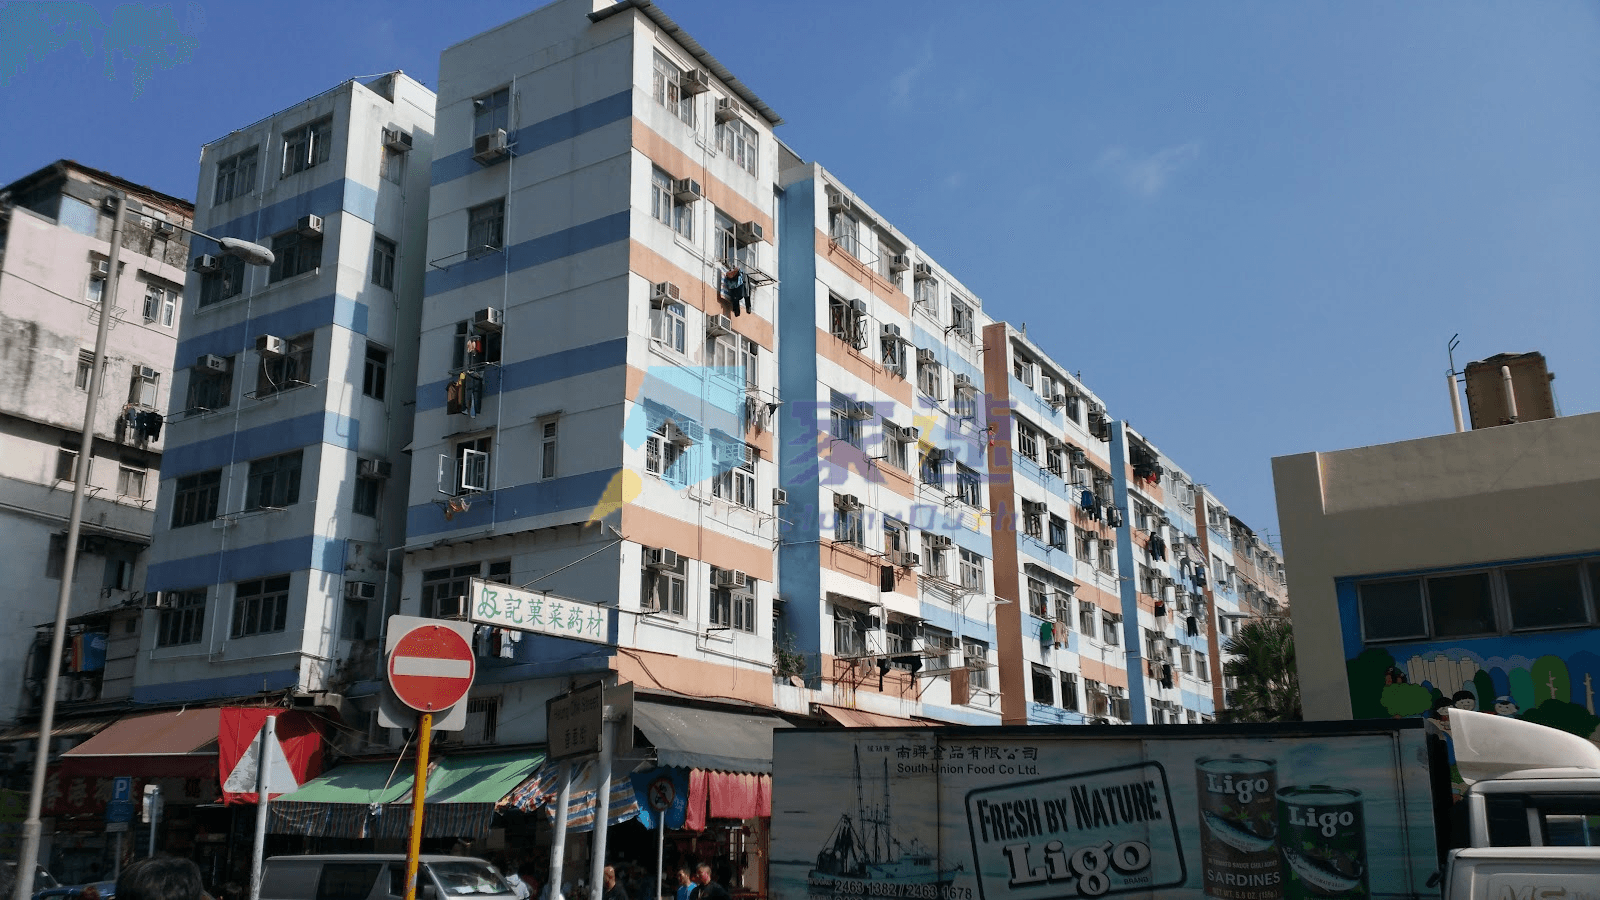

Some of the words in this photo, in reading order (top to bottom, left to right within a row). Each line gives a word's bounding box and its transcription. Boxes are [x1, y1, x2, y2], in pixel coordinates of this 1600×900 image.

[897, 763, 928, 773] South
[930, 764, 964, 774] Union
[967, 764, 995, 774] Food
[999, 765, 1014, 774] Co
[1018, 765, 1040, 775] Ltd.
[115, 779, 128, 799] P
[1207, 774, 1269, 804] Ligo
[976, 798, 1043, 843] FRESH
[1043, 797, 1069, 833] BY
[1069, 780, 1162, 831] NATURE
[1288, 805, 1354, 837] Ligo
[1002, 839, 1152, 897] Ligo
[1207, 869, 1281, 887] SARDINES
[834, 880, 864, 894] 2463
[867, 881, 896, 896] 1382
[906, 883, 937, 898] 2463
[942, 886, 972, 900] 1678
[1124, 876, 1149, 885] BRAND
